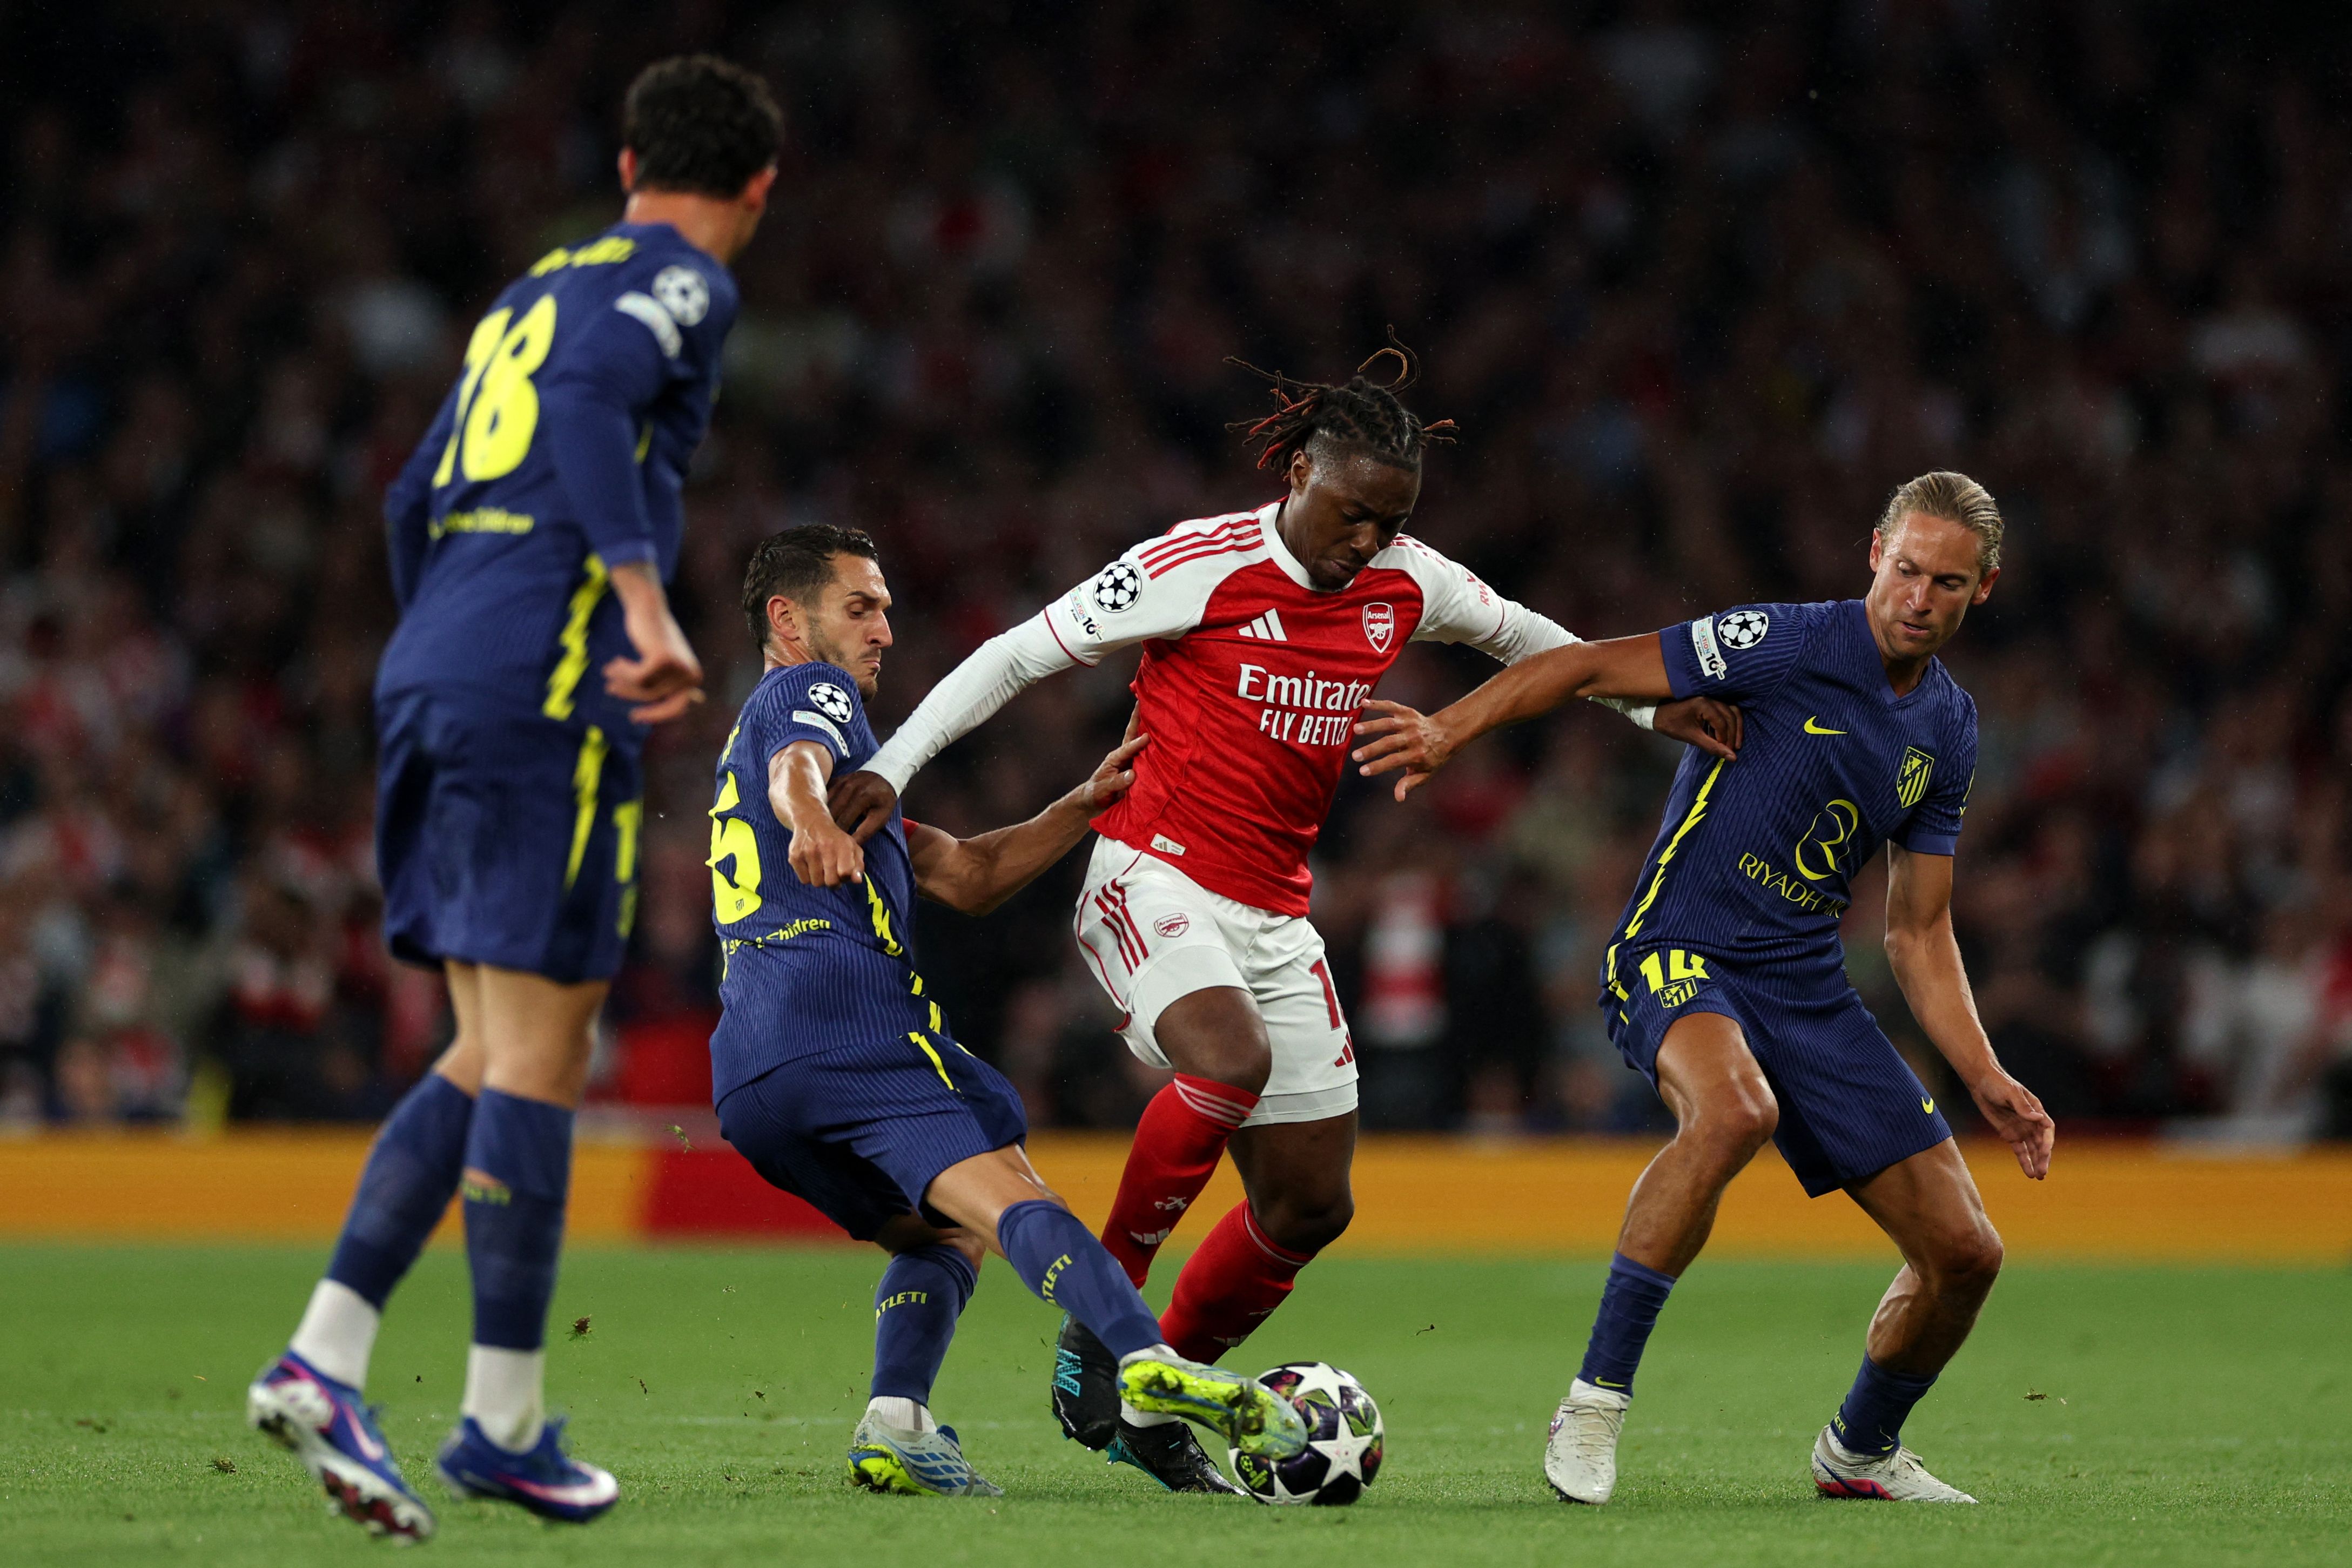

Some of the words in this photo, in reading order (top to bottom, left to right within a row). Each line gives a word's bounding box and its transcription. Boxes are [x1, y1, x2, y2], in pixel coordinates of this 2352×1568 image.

[432, 293, 557, 488] 18
[1367, 611, 1389, 620] Arsenal
[1238, 663, 1374, 711] Emirate
[1259, 709, 1296, 742] FLY
[1738, 852, 1825, 911] RIYADH
[1159, 916, 1184, 926] Arsenal
[1308, 957, 1348, 1032] 1
[1639, 949, 1710, 994] 14
